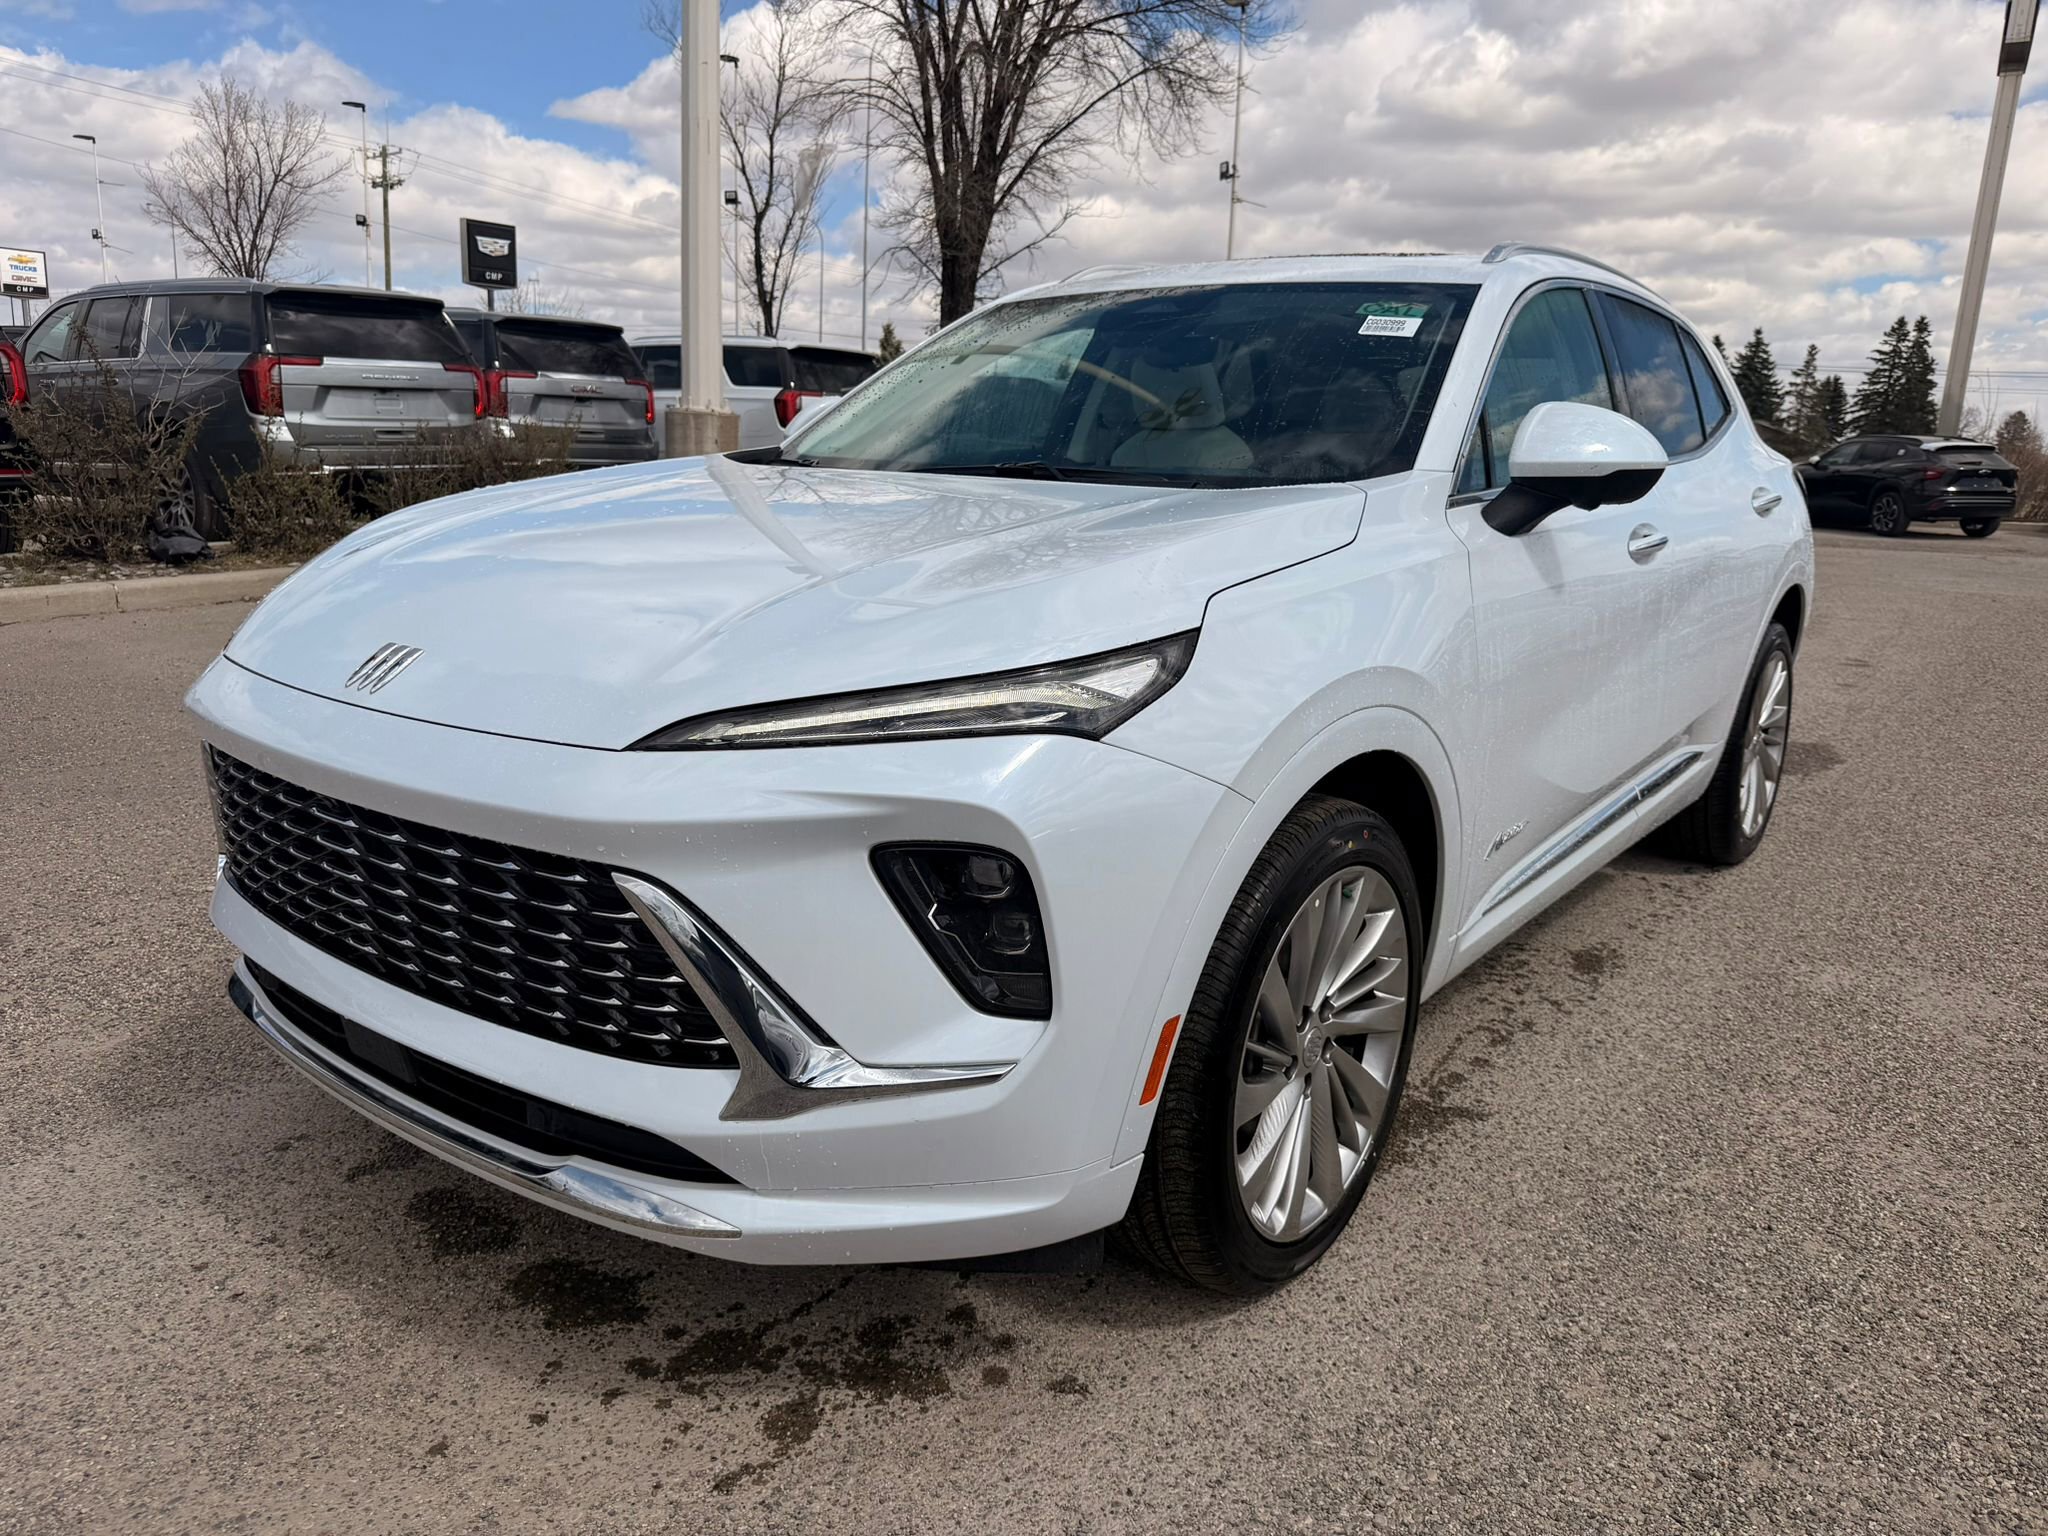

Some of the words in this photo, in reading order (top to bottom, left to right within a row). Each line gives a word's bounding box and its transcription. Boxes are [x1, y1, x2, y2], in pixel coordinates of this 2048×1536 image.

[9, 264, 37, 272] TRUCKS
[11, 275, 37, 283] GMC
[485, 271, 503, 281] CMP
